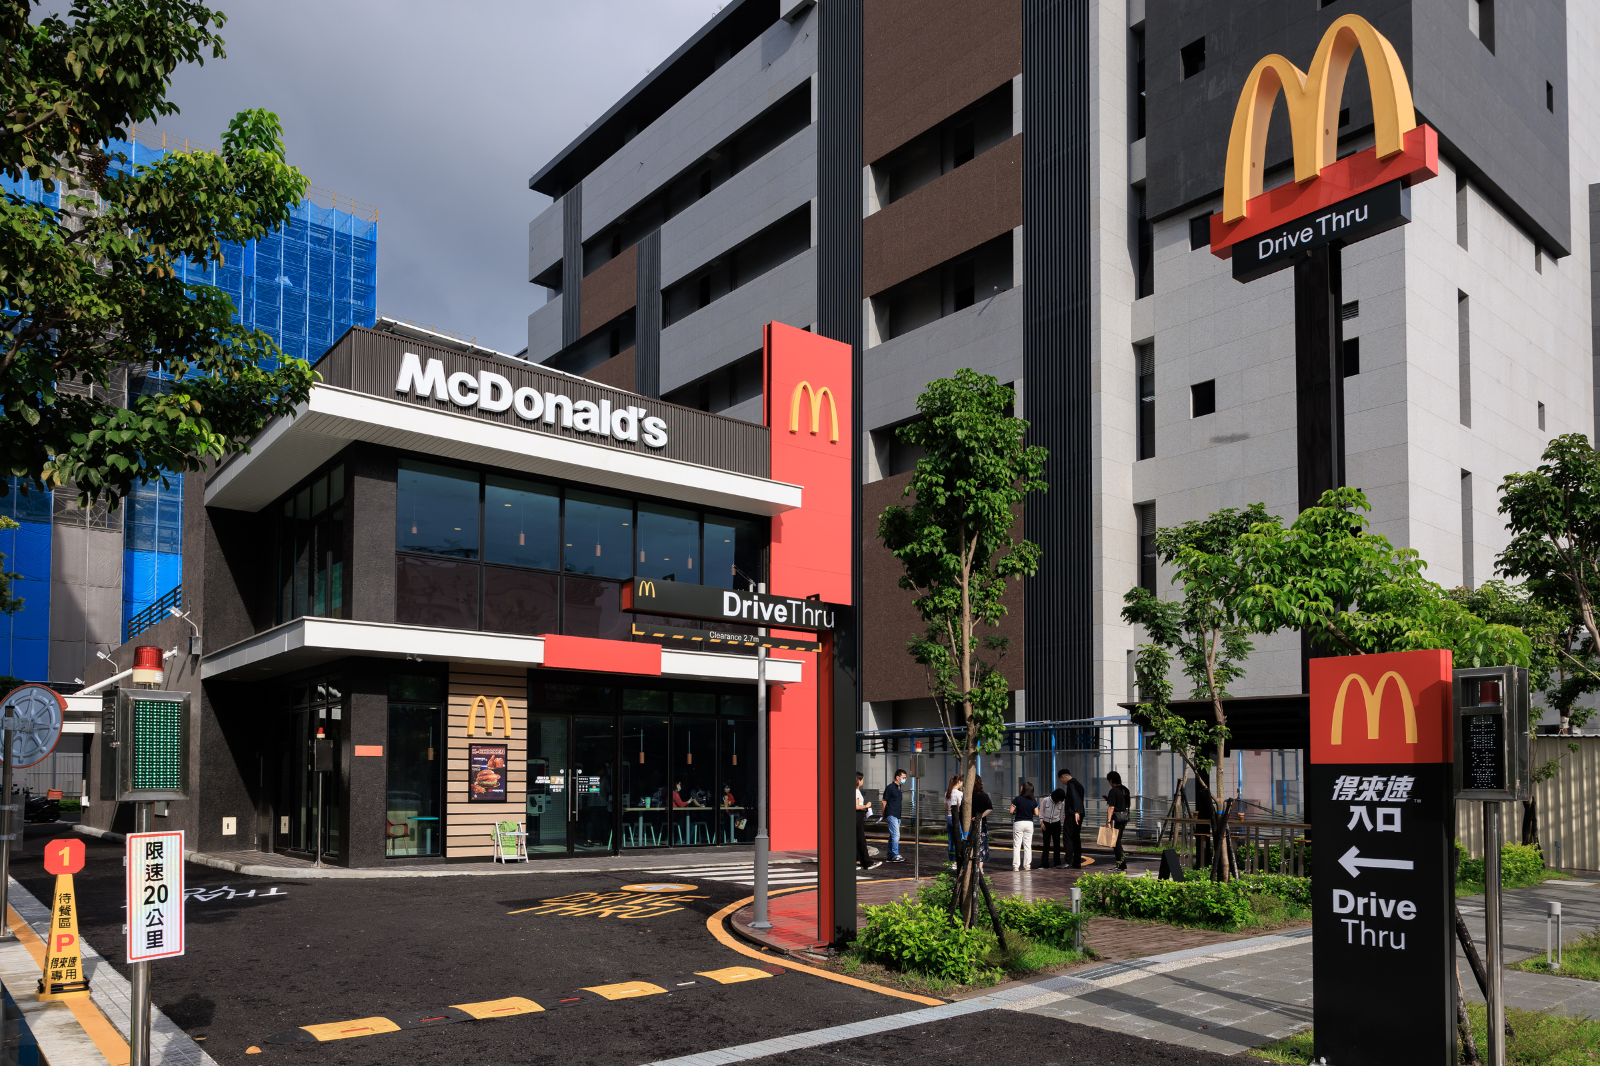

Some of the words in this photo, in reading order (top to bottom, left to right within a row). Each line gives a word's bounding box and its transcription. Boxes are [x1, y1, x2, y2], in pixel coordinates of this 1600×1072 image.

[1258, 227, 1313, 259] Drive
[1316, 204, 1368, 236] Thru
[395, 352, 669, 448] McDonald's
[709, 631, 742, 641] Clearance
[743, 634, 760, 643] 2.7m
[1332, 775, 1416, 803] 得來速
[1346, 805, 1402, 833] 入口
[58, 846, 71, 867] 1
[58, 892, 72, 929] 待餐區
[506, 902, 685, 919] THRU
[539, 891, 711, 907] DRIVE
[1332, 888, 1417, 921] Drive
[56, 933, 75, 953] P
[1340, 918, 1406, 950] Thru
[50, 956, 78, 969] 得來速
[50, 968, 77, 981] 專用
